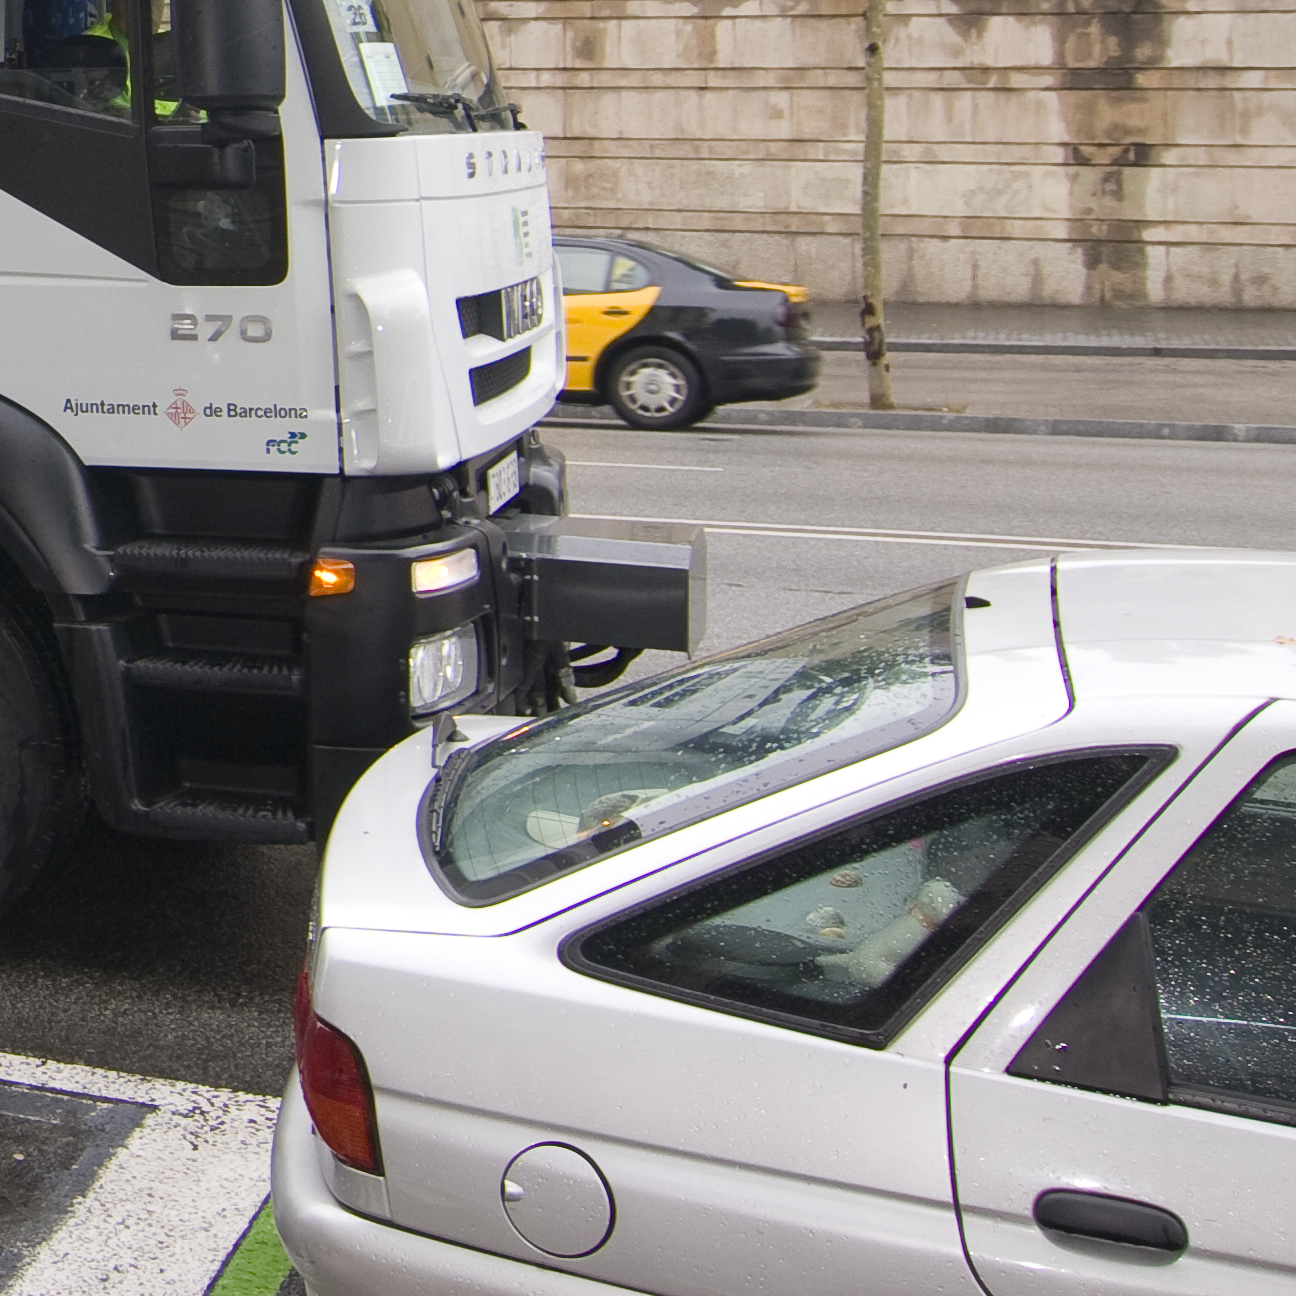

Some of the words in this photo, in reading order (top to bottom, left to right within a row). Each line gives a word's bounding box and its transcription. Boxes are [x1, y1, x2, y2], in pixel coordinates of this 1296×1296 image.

[170, 313, 273, 343] 270
[63, 398, 159, 417] Ajuntament
[203, 402, 223, 418] de
[226, 402, 309, 419] Barcelona
